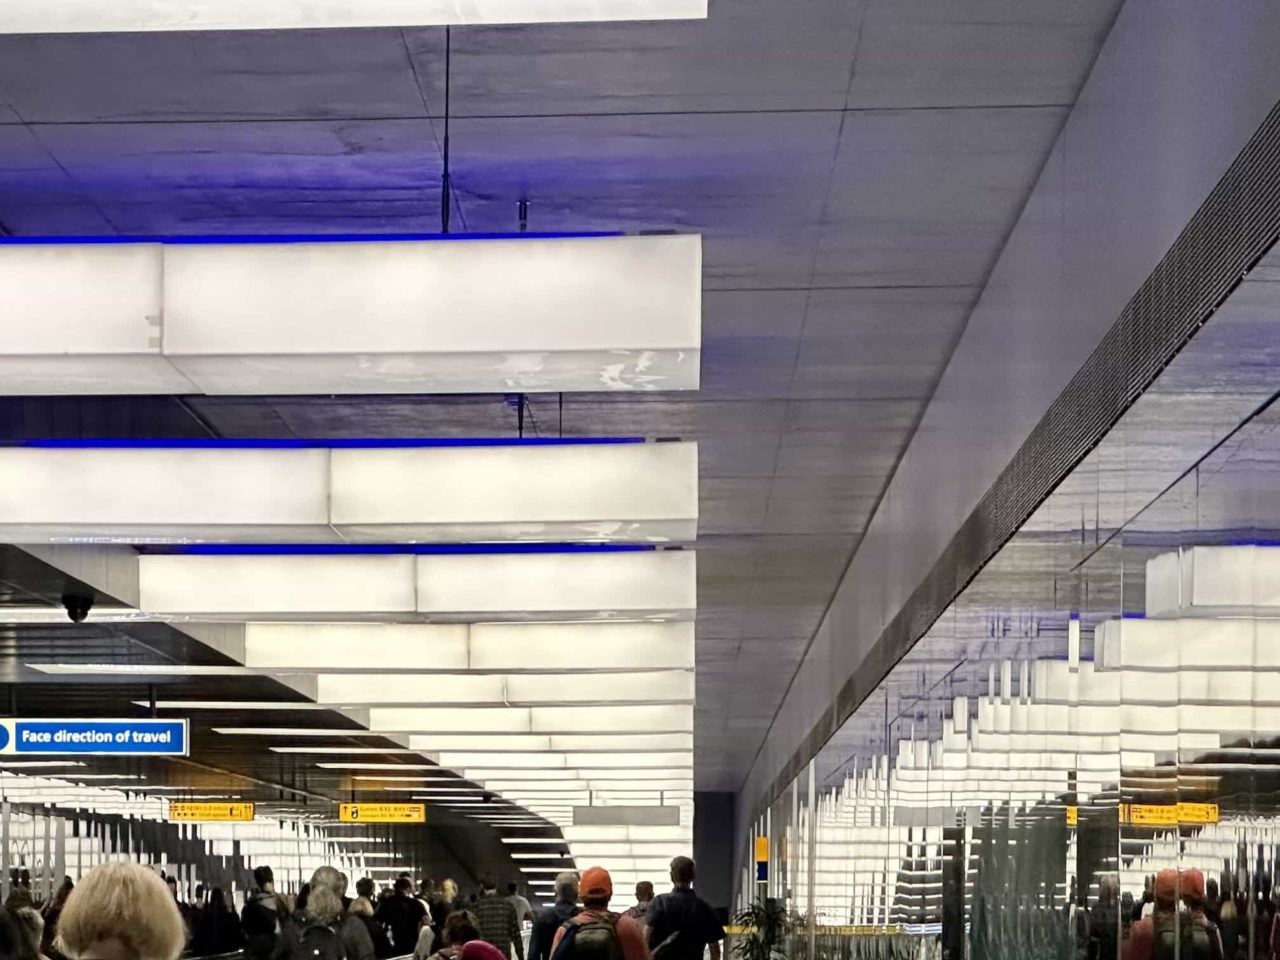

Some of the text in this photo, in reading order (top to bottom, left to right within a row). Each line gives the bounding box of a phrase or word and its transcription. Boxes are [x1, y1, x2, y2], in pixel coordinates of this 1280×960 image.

[22, 730, 171, 742] Face direction of travel
